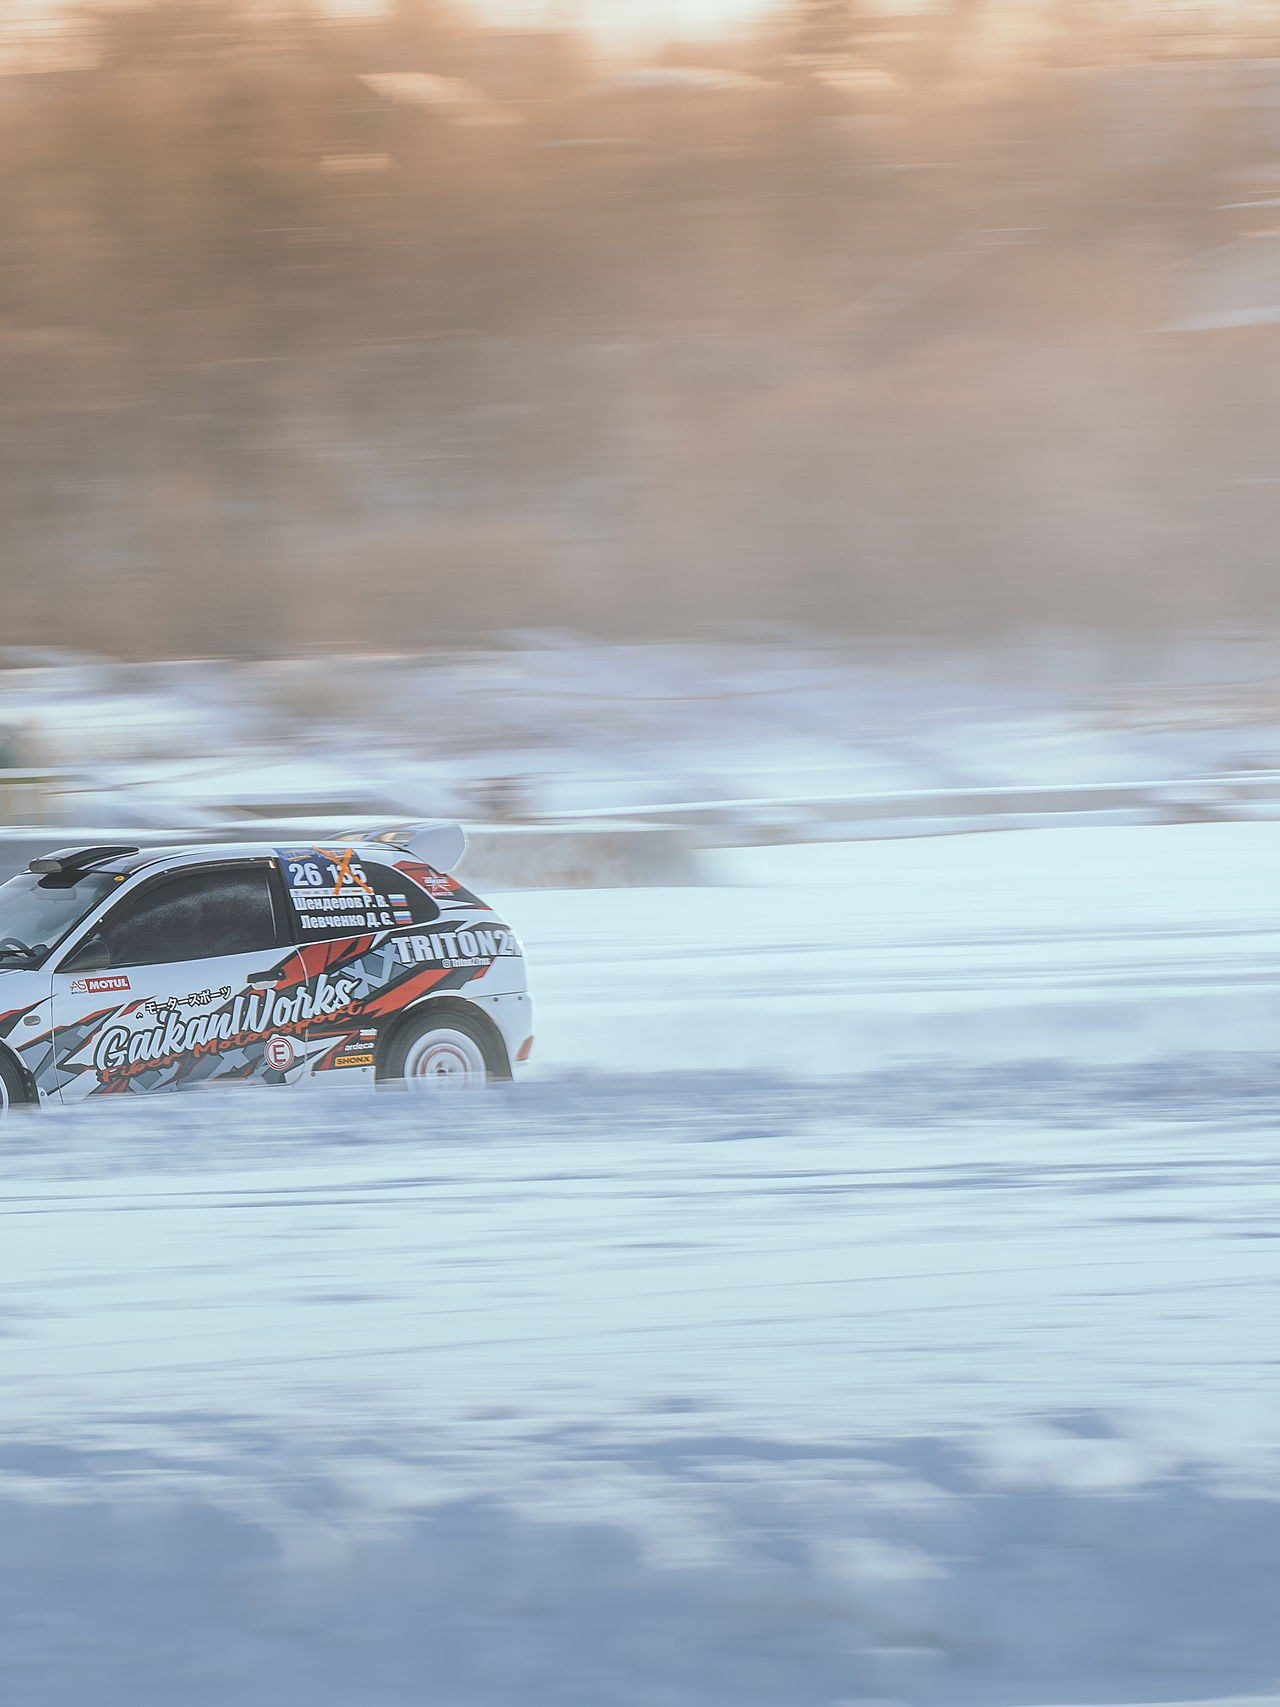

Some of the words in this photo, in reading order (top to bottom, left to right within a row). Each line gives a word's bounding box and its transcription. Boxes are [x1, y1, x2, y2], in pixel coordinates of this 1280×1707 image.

[288, 862, 323, 886] 26
[293, 896, 364, 911] Шендеров
[300, 914, 366, 928] Левченко
[89, 979, 128, 990] MOTUL
[145, 986, 232, 1014] モータースポーツ
[272, 1044, 286, 1063] E
[345, 1043, 374, 1051] ardeca
